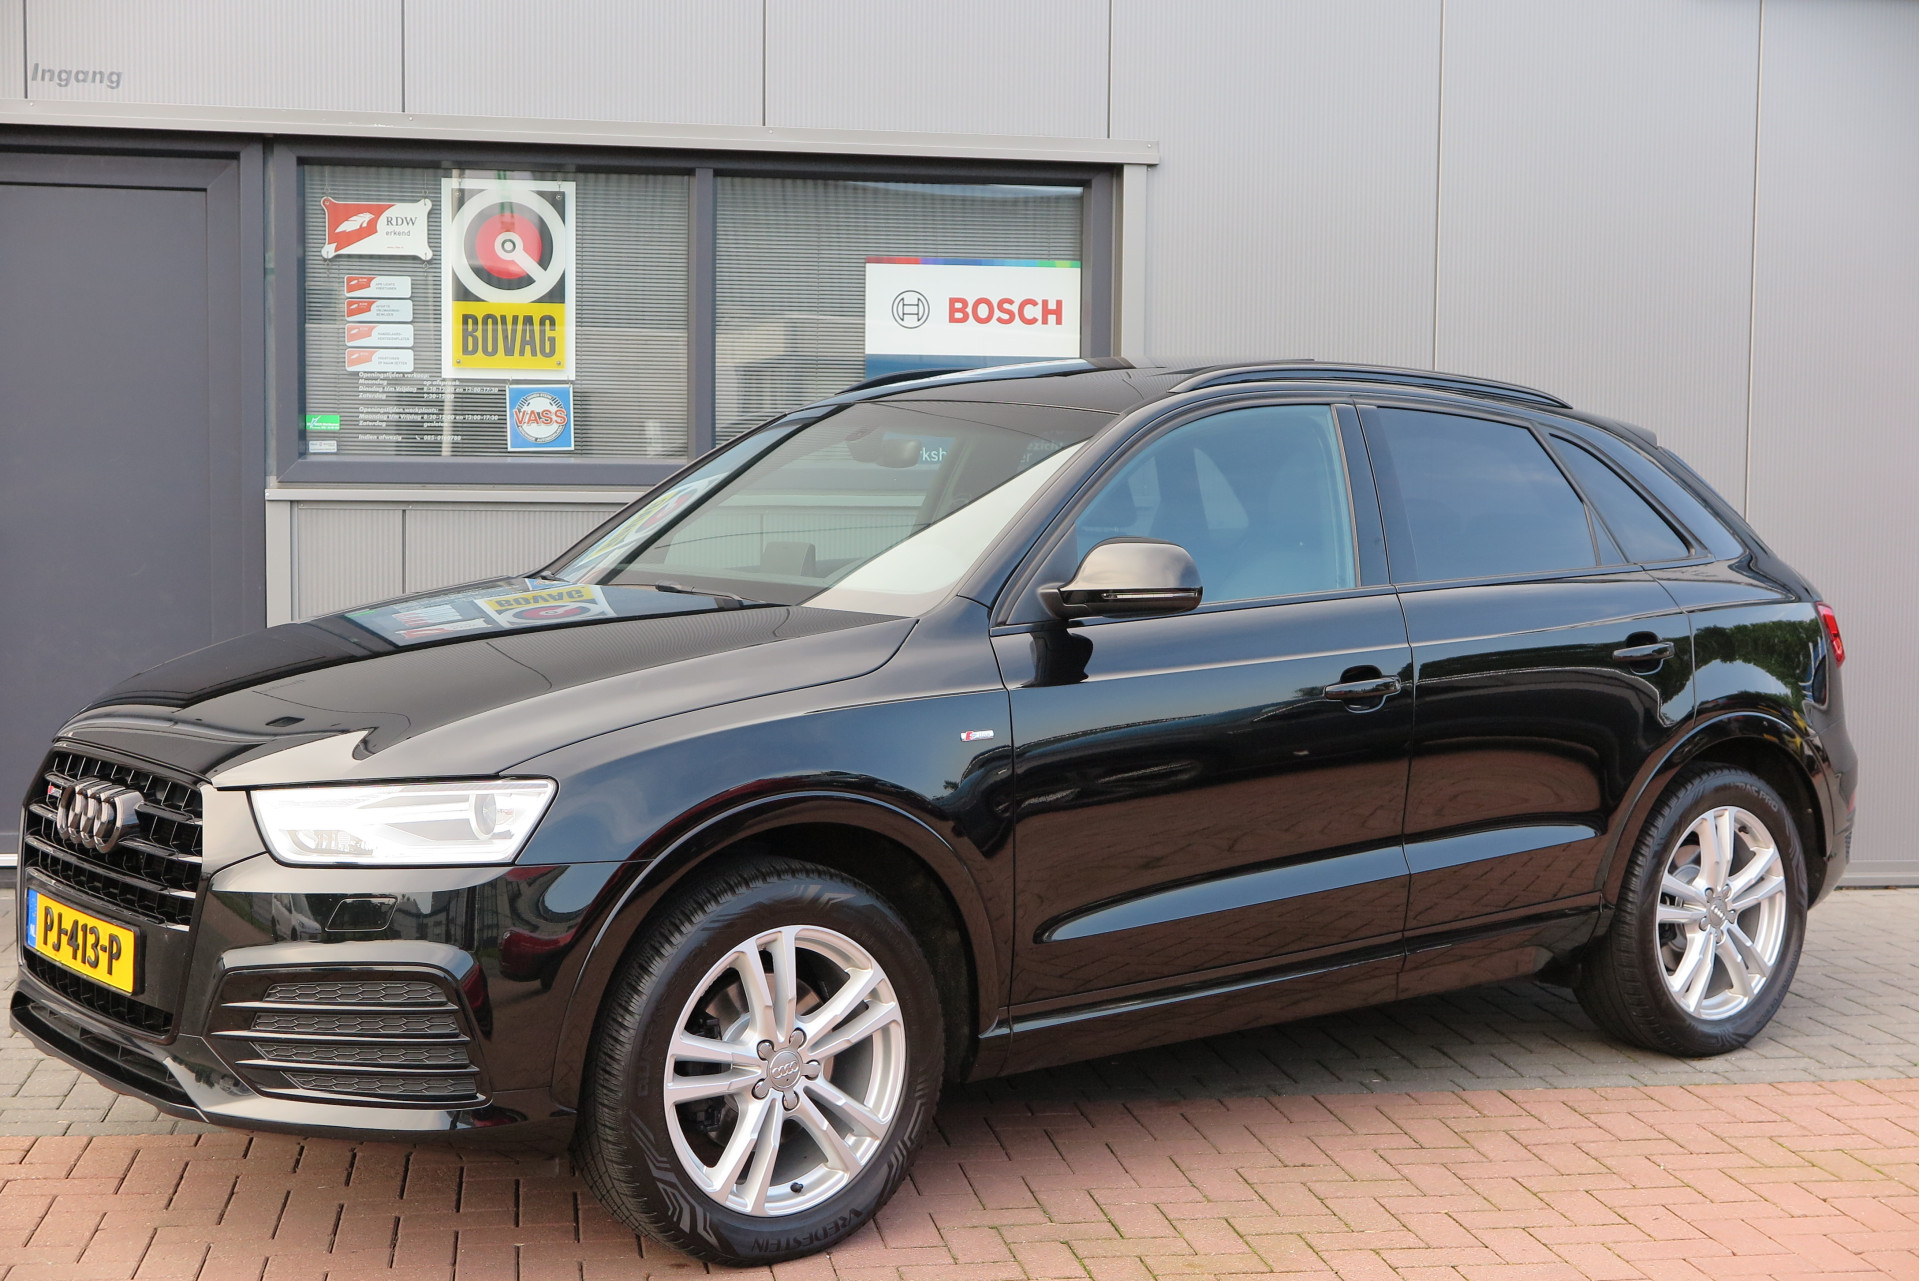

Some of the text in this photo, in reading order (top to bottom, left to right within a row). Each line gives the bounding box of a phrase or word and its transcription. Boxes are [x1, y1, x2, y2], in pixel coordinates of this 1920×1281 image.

[31, 62, 122, 90] Ingang
[385, 216, 418, 226] RDW
[385, 229, 411, 237] erkend
[948, 297, 1063, 326] BOSCH
[461, 313, 556, 358] BOVAG
[514, 408, 568, 425] VASS
[43, 905, 122, 976] PJ-413-P
[751, 1208, 864, 1253] VREDESTEIN
